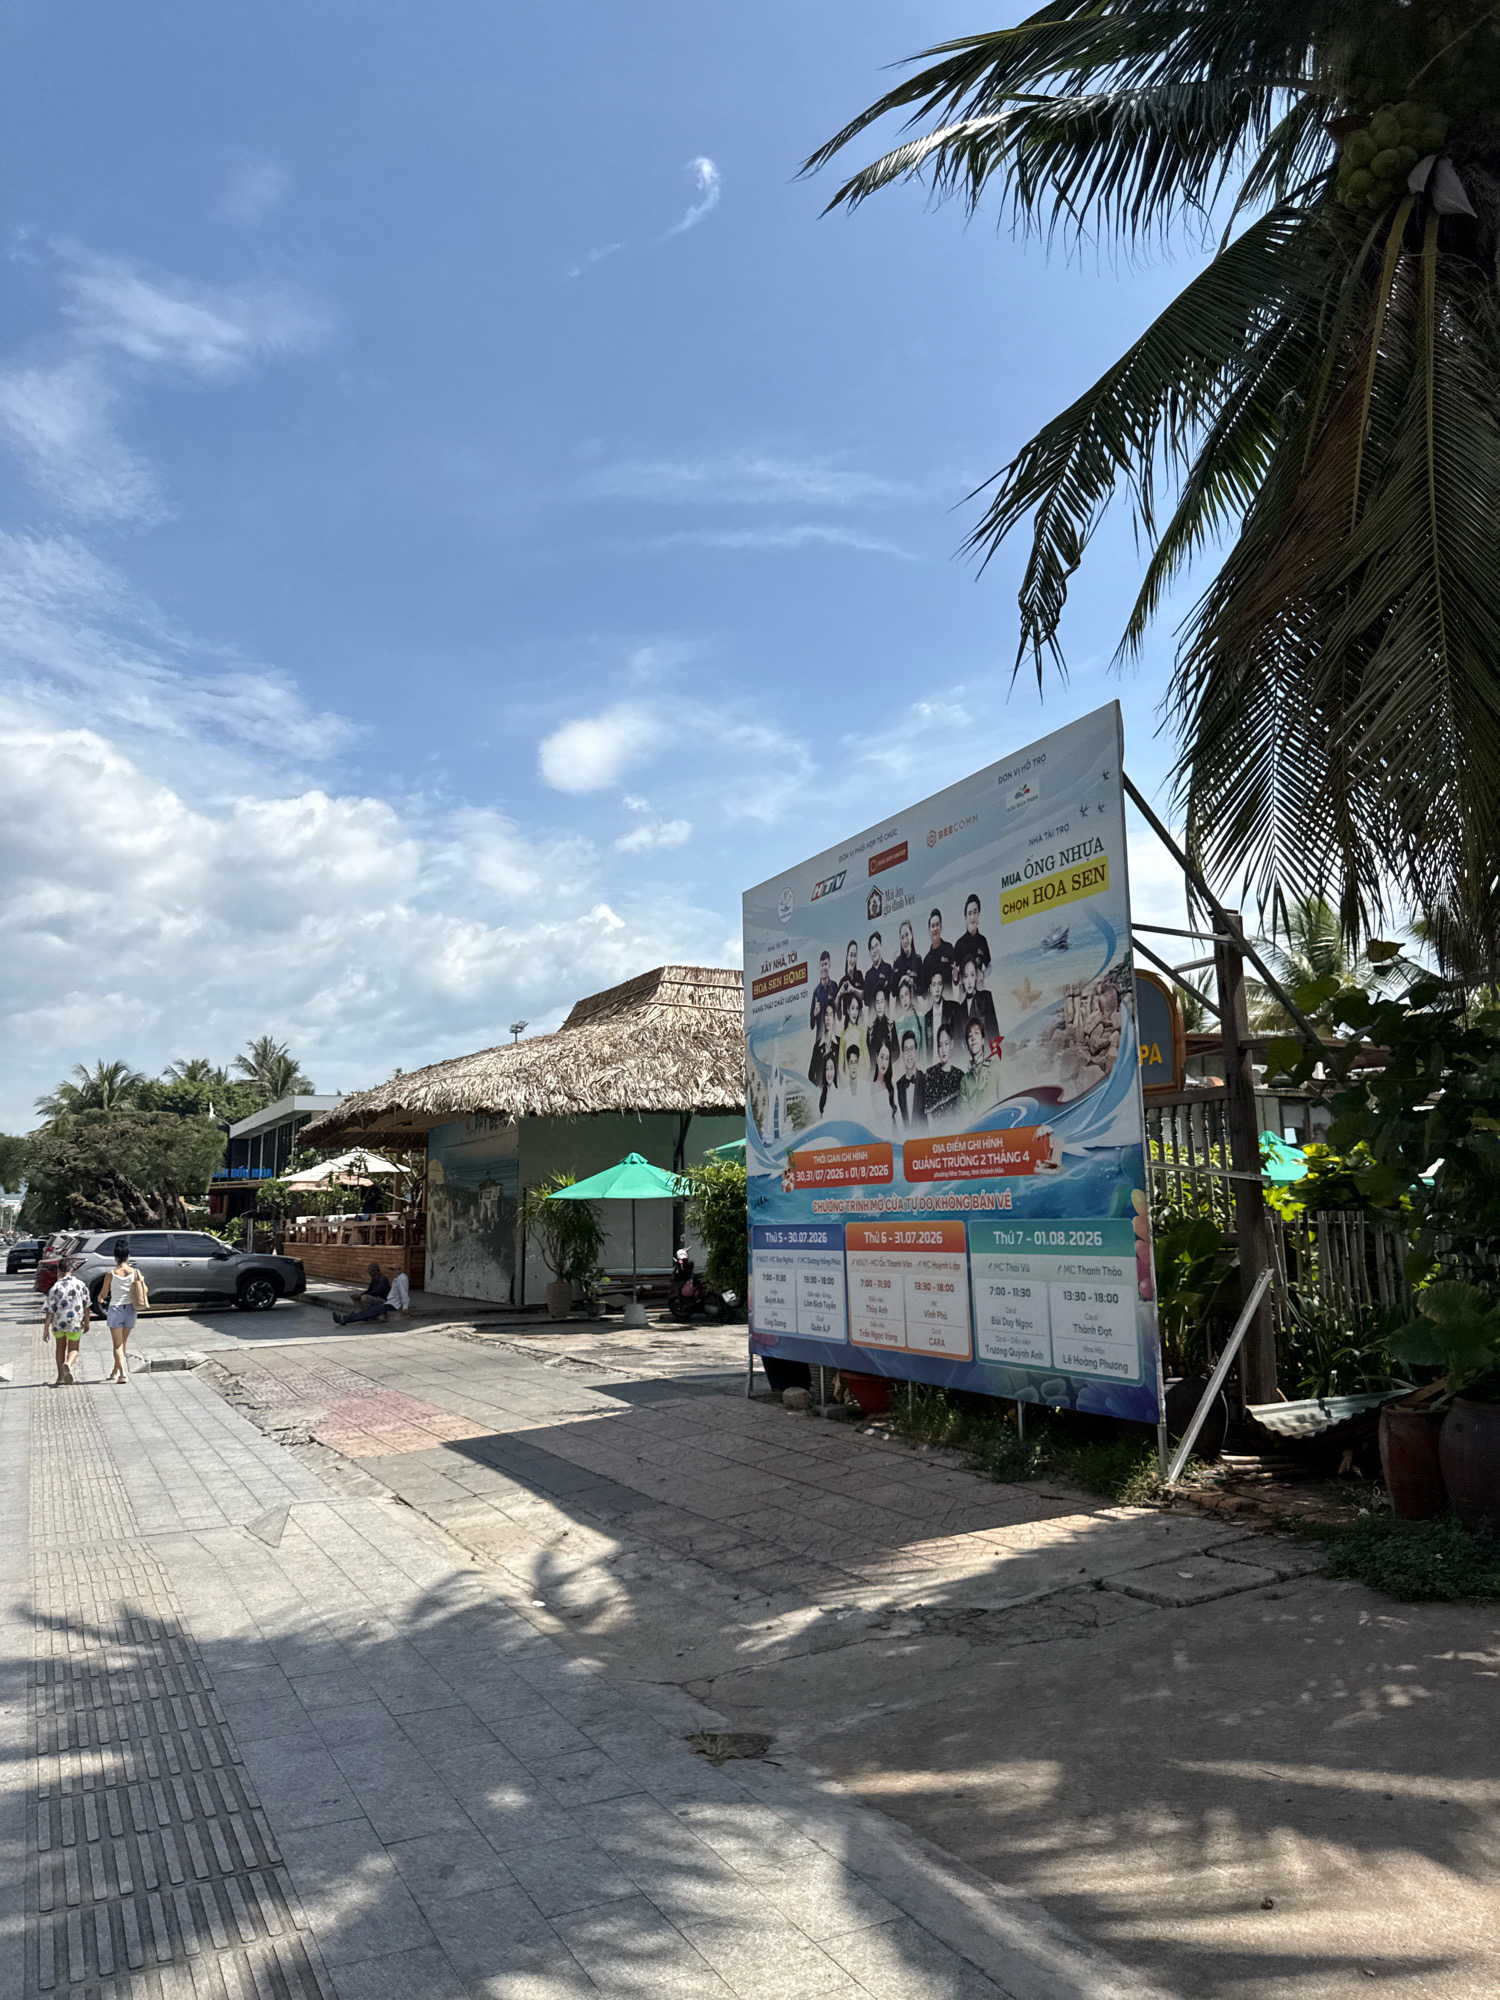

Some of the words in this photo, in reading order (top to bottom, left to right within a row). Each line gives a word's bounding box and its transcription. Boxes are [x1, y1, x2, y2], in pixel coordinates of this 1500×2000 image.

[938, 813, 978, 840] BEECOMM
[1002, 871, 1022, 888] MUA
[1024, 854, 1056, 879] ỐNG
[1059, 836, 1105, 866] NHỰA
[811, 870, 847, 901] HTV
[1002, 896, 1029, 915] CHỌN
[1032, 880, 1068, 905] HOA
[1072, 864, 1106, 891] SEN
[754, 981, 768, 996] HOA
[768, 976, 782, 990] SEN
[784, 968, 806, 985] HOME
[932, 1143, 946, 1154] ĐỊA
[946, 1137, 966, 1152] ĐIỂM
[968, 1140, 981, 1150] GHI
[982, 1136, 1003, 1148] HÌNH
[813, 1152, 826, 1164] THỜI
[828, 1153, 841, 1164] GIAN
[842, 1152, 852, 1162] GHI
[853, 1150, 868, 1160] HÌNH
[912, 1156, 941, 1170] QUẢNG
[942, 1152, 978, 1167] TRƯỜNG
[980, 1154, 986, 1165] 2
[988, 1148, 1022, 1164] THÁNG
[1022, 1150, 1030, 1162] 4
[850, 1164, 889, 1179] 01/8/2026
[813, 1198, 844, 1212] CHƯƠNG
[870, 1193, 884, 1212] MỞ
[885, 1193, 904, 1212] CỬA
[906, 1196, 918, 1214] TỰ
[920, 1196, 934, 1210] DO
[935, 1191, 972, 1210] KHÔNG
[972, 1190, 996, 1210] BÁN
[996, 1188, 1012, 1209] VÉ
[765, 1232, 778, 1243] Thứ
[778, 1232, 783, 1243] 5
[788, 1232, 828, 1243] 30.07.2026
[864, 1230, 880, 1244] Thứ
[881, 1232, 887, 1244] 6
[894, 1231, 942, 1244] 31.07.2026
[994, 1230, 1014, 1245] Thứ
[1016, 1231, 1024, 1245] 7
[1034, 1231, 1102, 1246] 01.08.2026
[886, 1259, 902, 1268] Thanh
[994, 1262, 1004, 1272] MC
[1063, 1265, 1076, 1275] MC
[1078, 1265, 1100, 1276] Thanh
[1102, 1264, 1122, 1277] Thảo
[762, 1274, 772, 1282] 7:00
[804, 1276, 816, 1284] 13:30
[860, 1278, 872, 1288] 7:00
[878, 1280, 891, 1288] 11:30
[914, 1282, 931, 1291] 13:30
[936, 1283, 954, 1292] 18:00
[989, 1286, 1006, 1296] 7:00
[1012, 1287, 1031, 1298] 11:30
[1064, 1290, 1086, 1302] 13:30
[1094, 1292, 1119, 1304] 18:00
[878, 1306, 888, 1314] Anh
[1002, 1317, 1015, 1329] Duy
[1016, 1318, 1033, 1330] Ngọc
[1072, 1323, 1096, 1335] Thành
[1098, 1326, 1112, 1338] Đạt
[929, 1336, 946, 1347] CARA
[986, 1344, 1008, 1358] Trương
[1030, 1350, 1044, 1360] Anh
[1062, 1353, 1072, 1365] Lê
[1074, 1355, 1098, 1370] Hoàng
[1099, 1358, 1128, 1374] Phương
